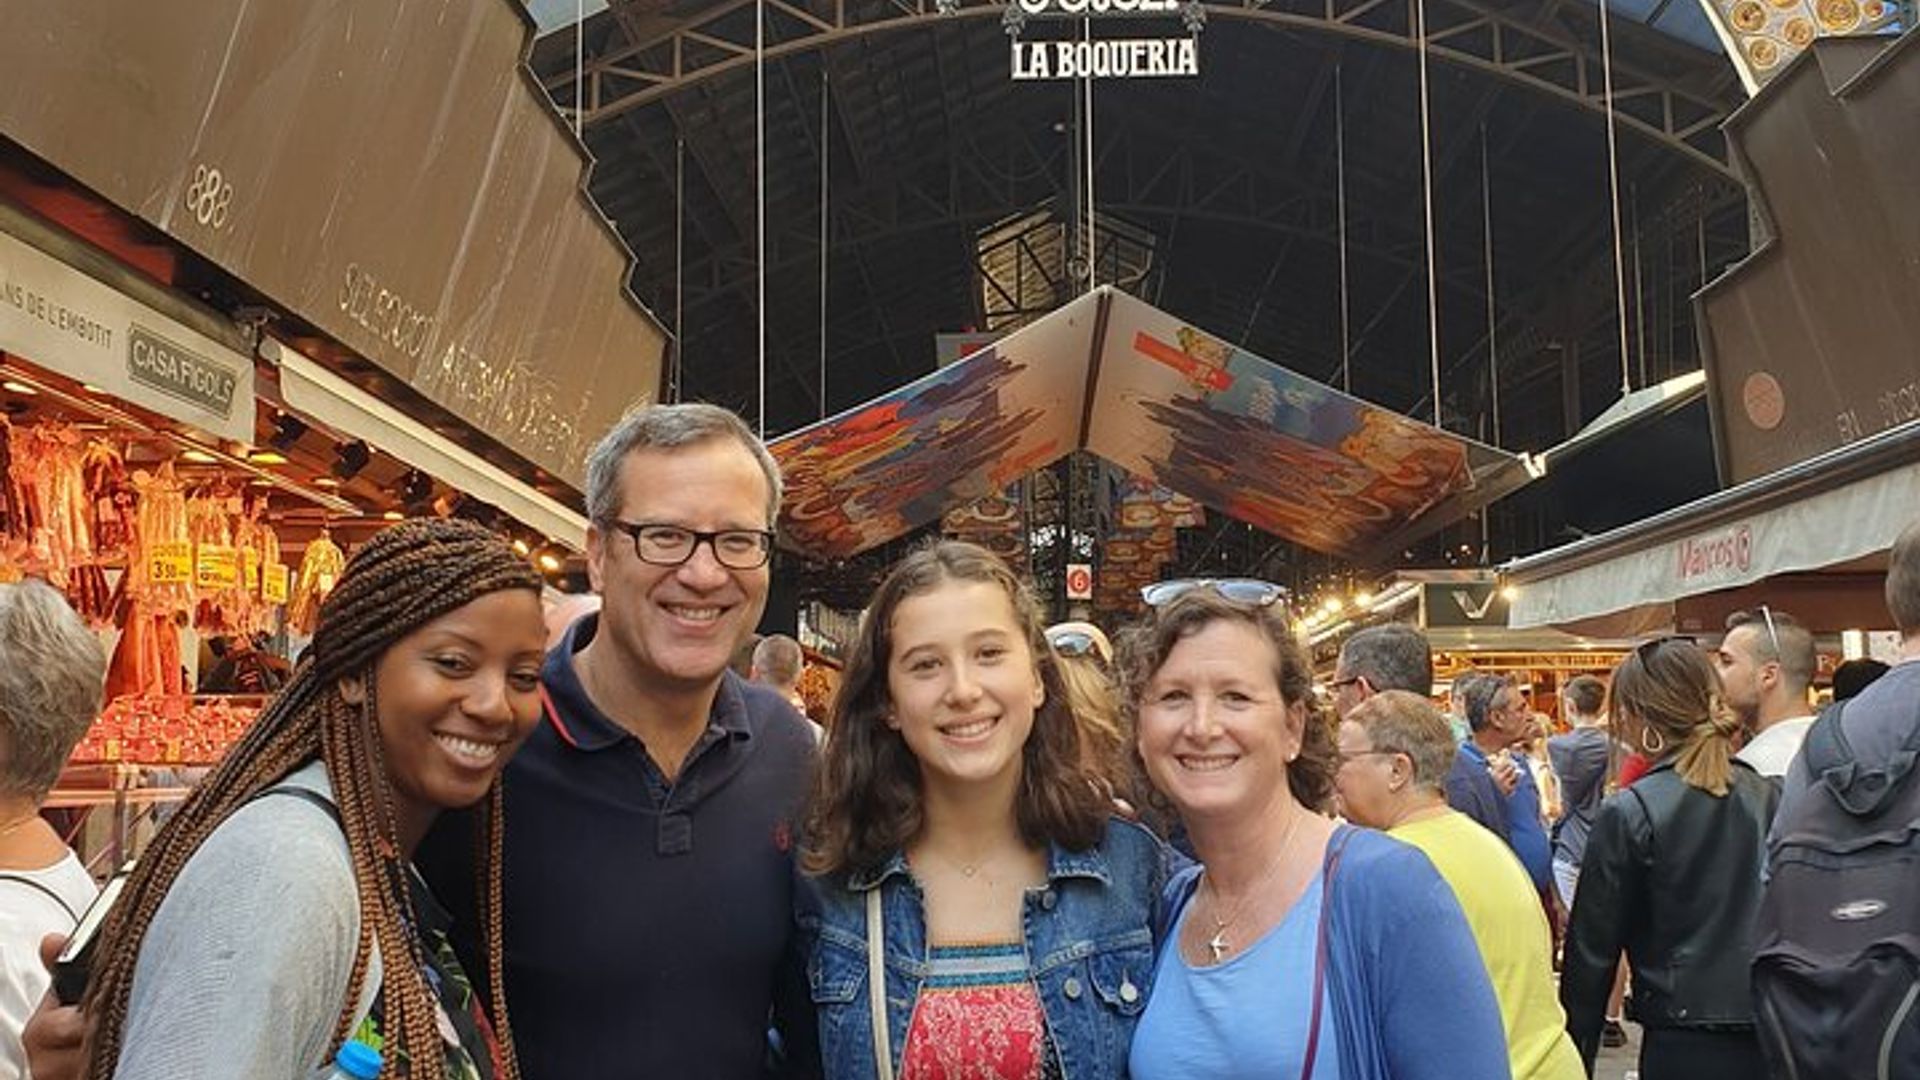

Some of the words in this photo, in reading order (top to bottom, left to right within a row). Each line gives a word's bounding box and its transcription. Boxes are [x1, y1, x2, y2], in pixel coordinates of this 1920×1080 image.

[1012, 42, 1049, 80] LA
[1056, 38, 1199, 78] BOQUERIA
[27, 292, 44, 319] DE
[133, 339, 178, 381] CASA
